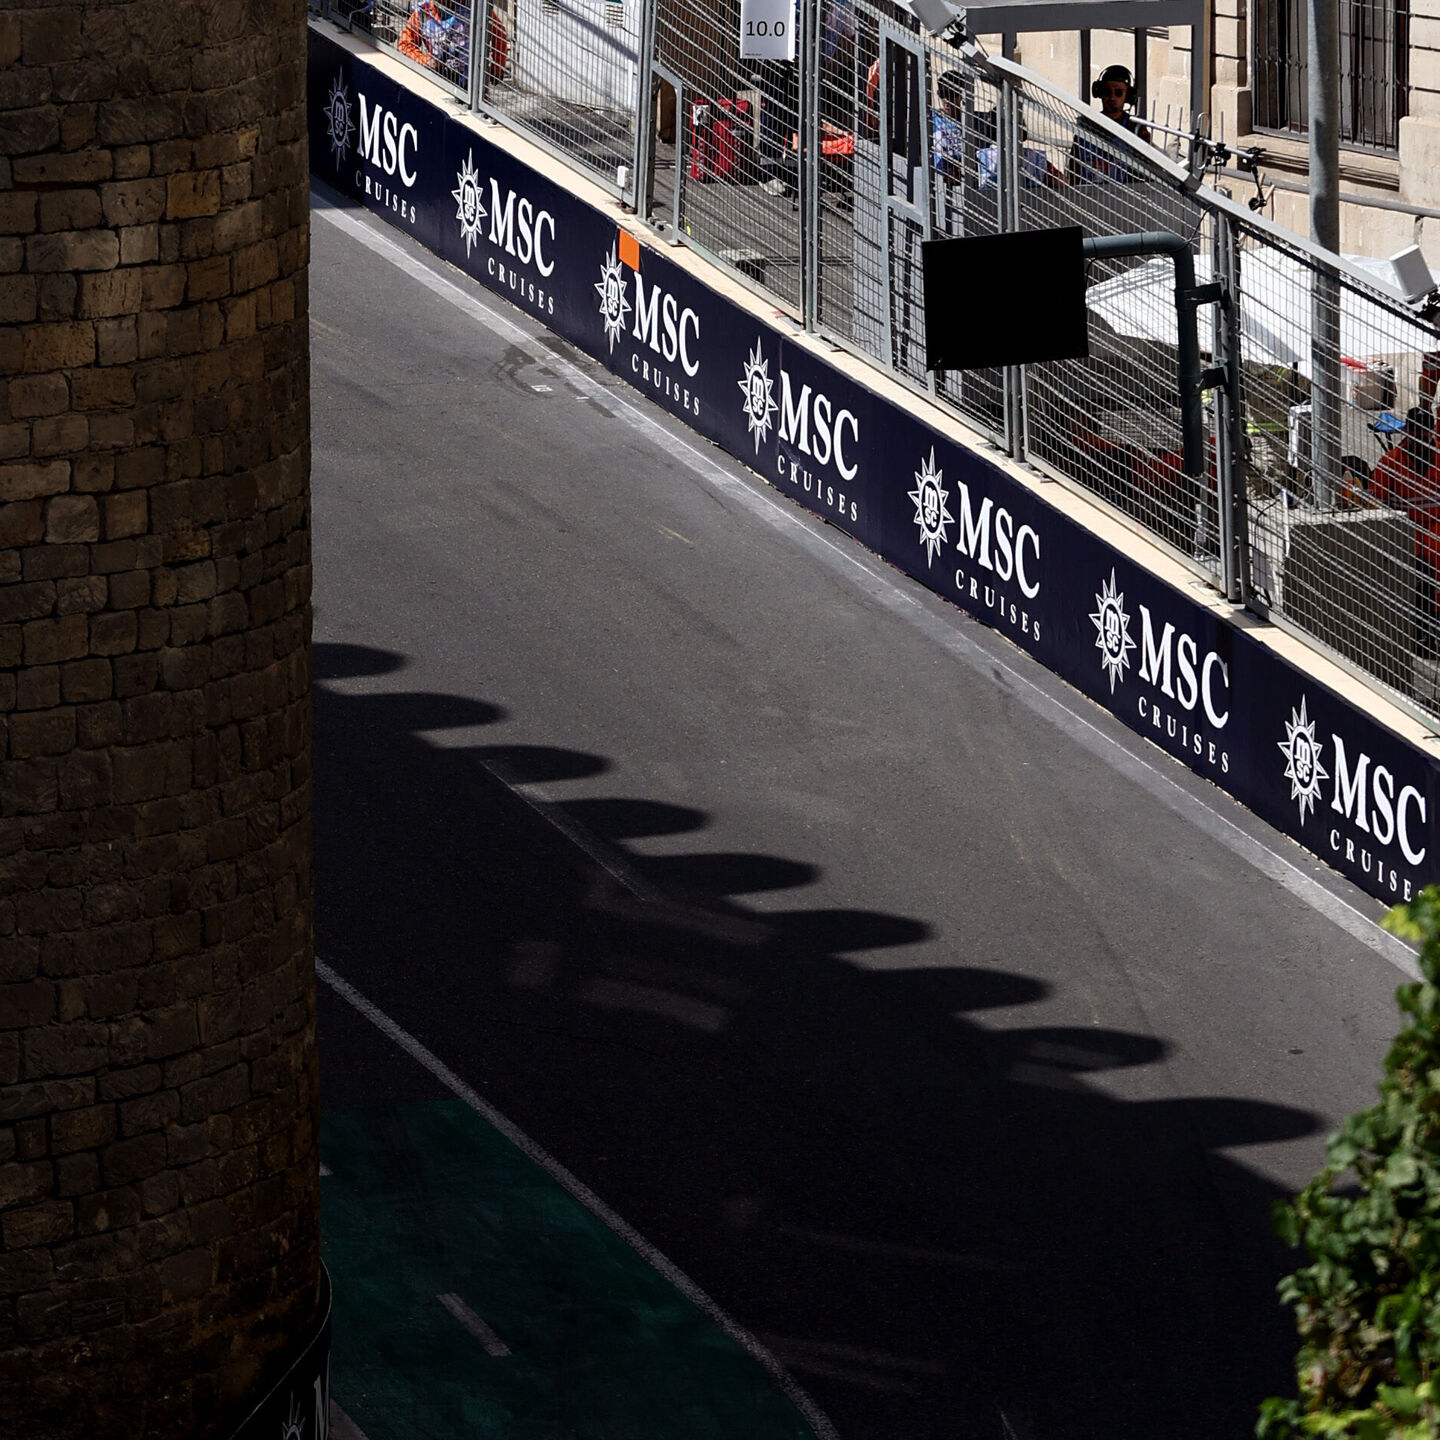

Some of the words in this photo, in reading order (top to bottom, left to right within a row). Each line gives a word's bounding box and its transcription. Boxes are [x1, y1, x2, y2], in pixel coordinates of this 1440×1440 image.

[746, 21, 786, 37] 10.0
[358, 92, 418, 187] MSC
[355, 170, 416, 224] CRUISES
[489, 177, 555, 277] MSC
[488, 257, 554, 315] CRUISES
[632, 271, 700, 377] MSC
[631, 353, 699, 416] CRUISES
[778, 369, 859, 481] MSC
[777, 454, 858, 521] CRUISES
[956, 480, 1040, 599] MSC
[956, 569, 1040, 642] CRUISES
[1138, 604, 1230, 729] MSC
[1138, 696, 1230, 773] CRUISES
[1331, 733, 1426, 865] MSC
